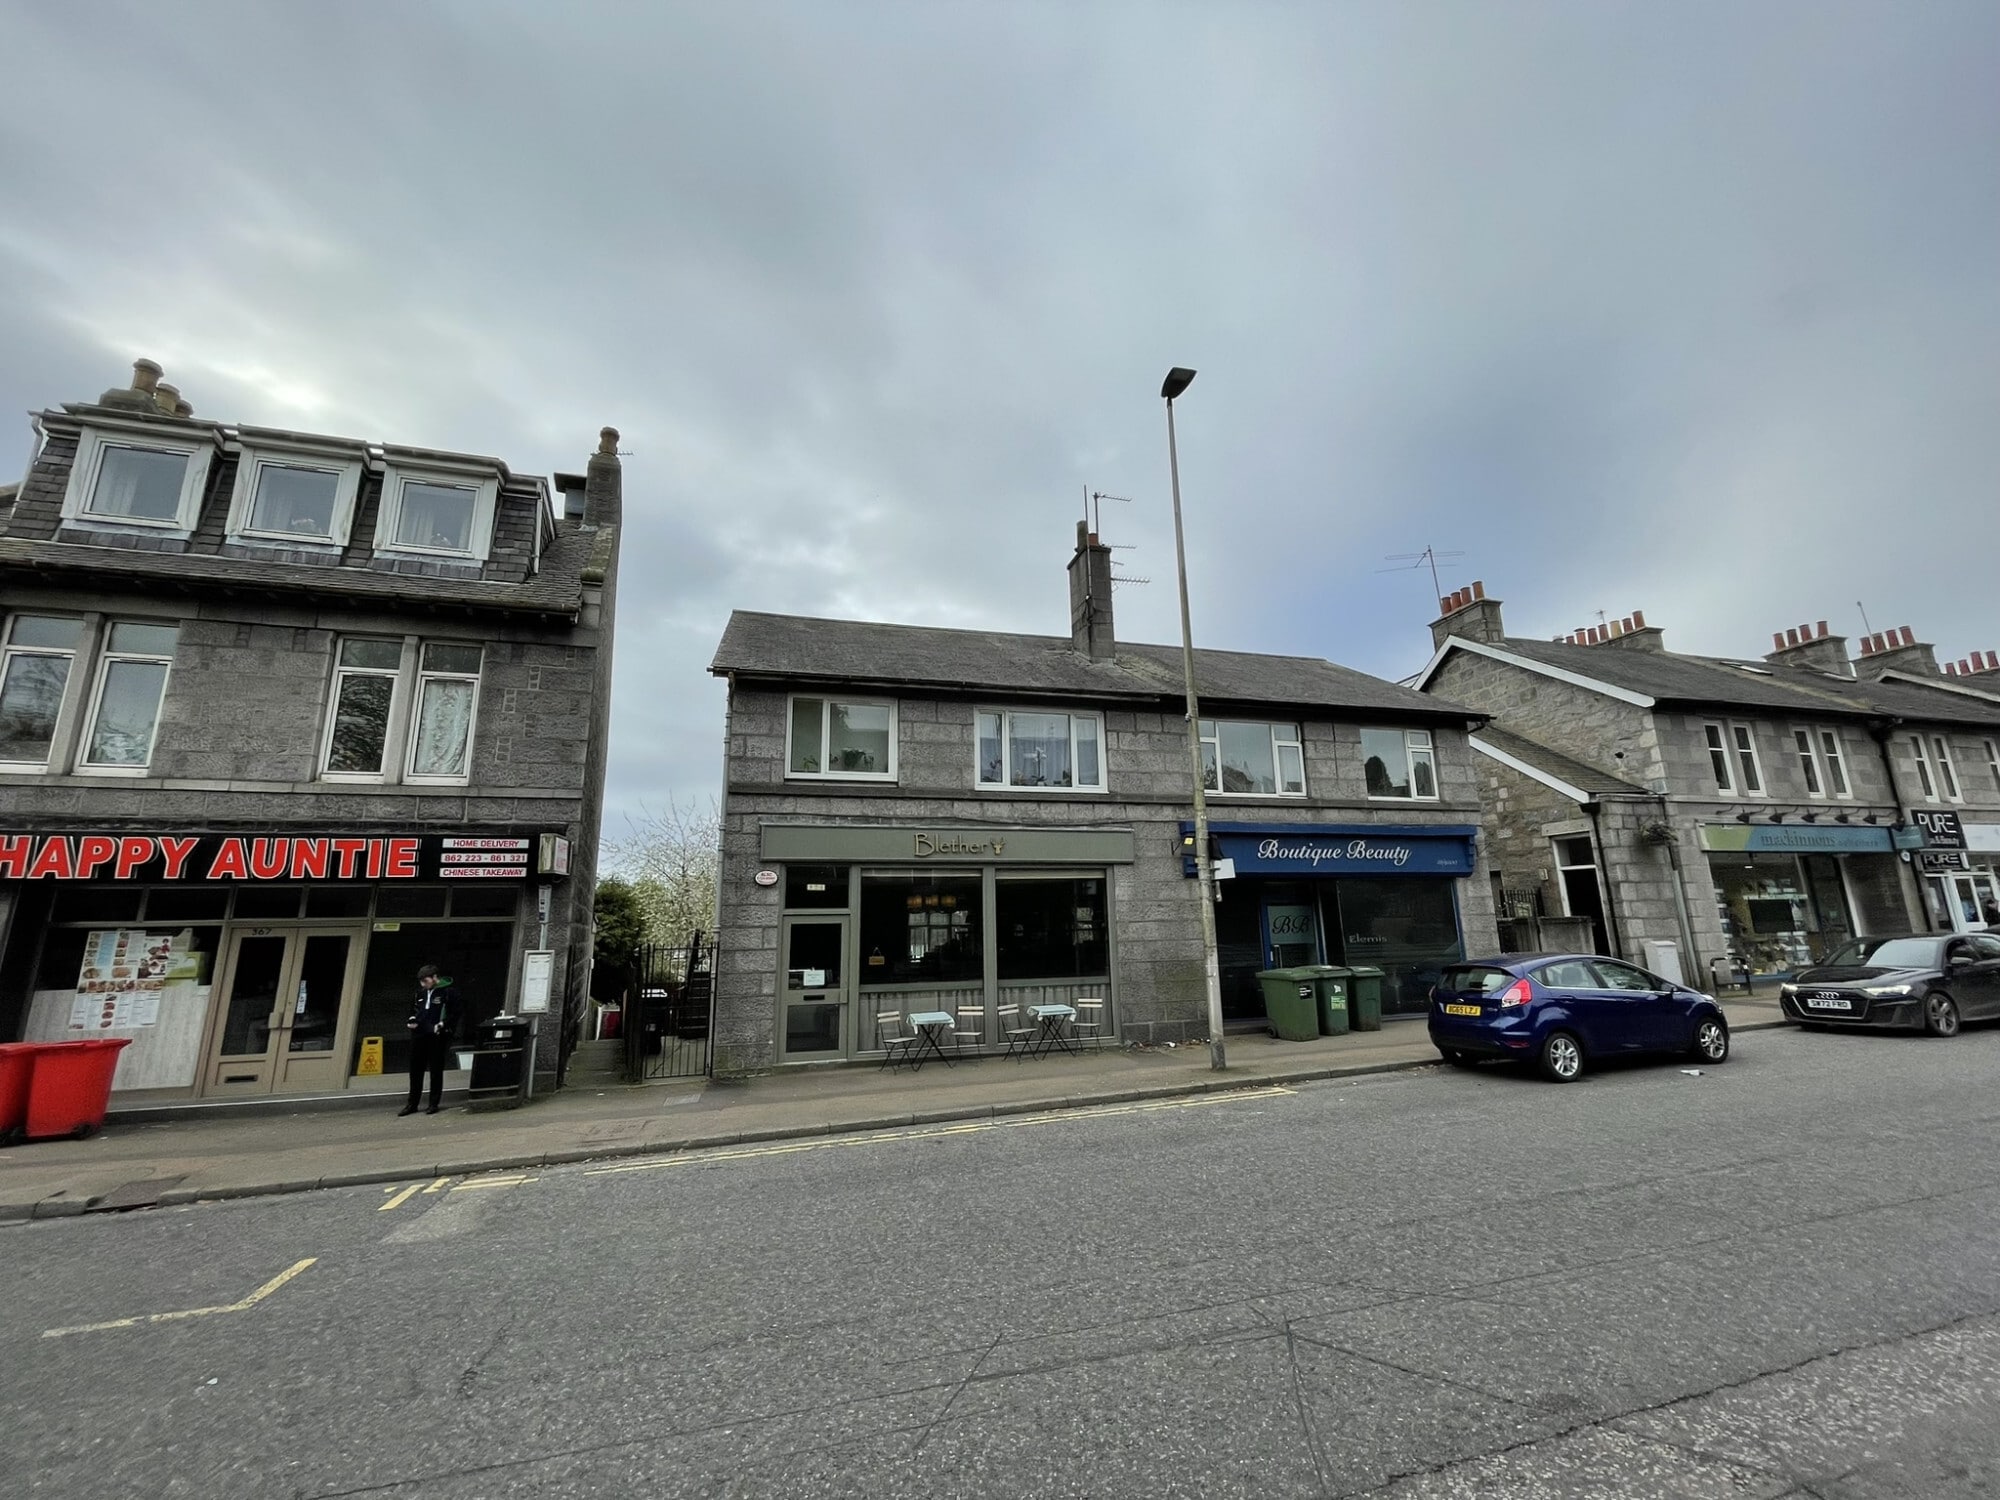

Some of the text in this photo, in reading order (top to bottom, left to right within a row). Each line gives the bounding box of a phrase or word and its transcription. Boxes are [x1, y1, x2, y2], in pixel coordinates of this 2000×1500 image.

[1917, 813, 1957, 833] PURE
[0, 835, 420, 879] HAPPY AUNTIE
[914, 832, 987, 857] Blether
[1257, 839, 1411, 866] Boutique Beauty
[1924, 854, 1959, 864] PURE
